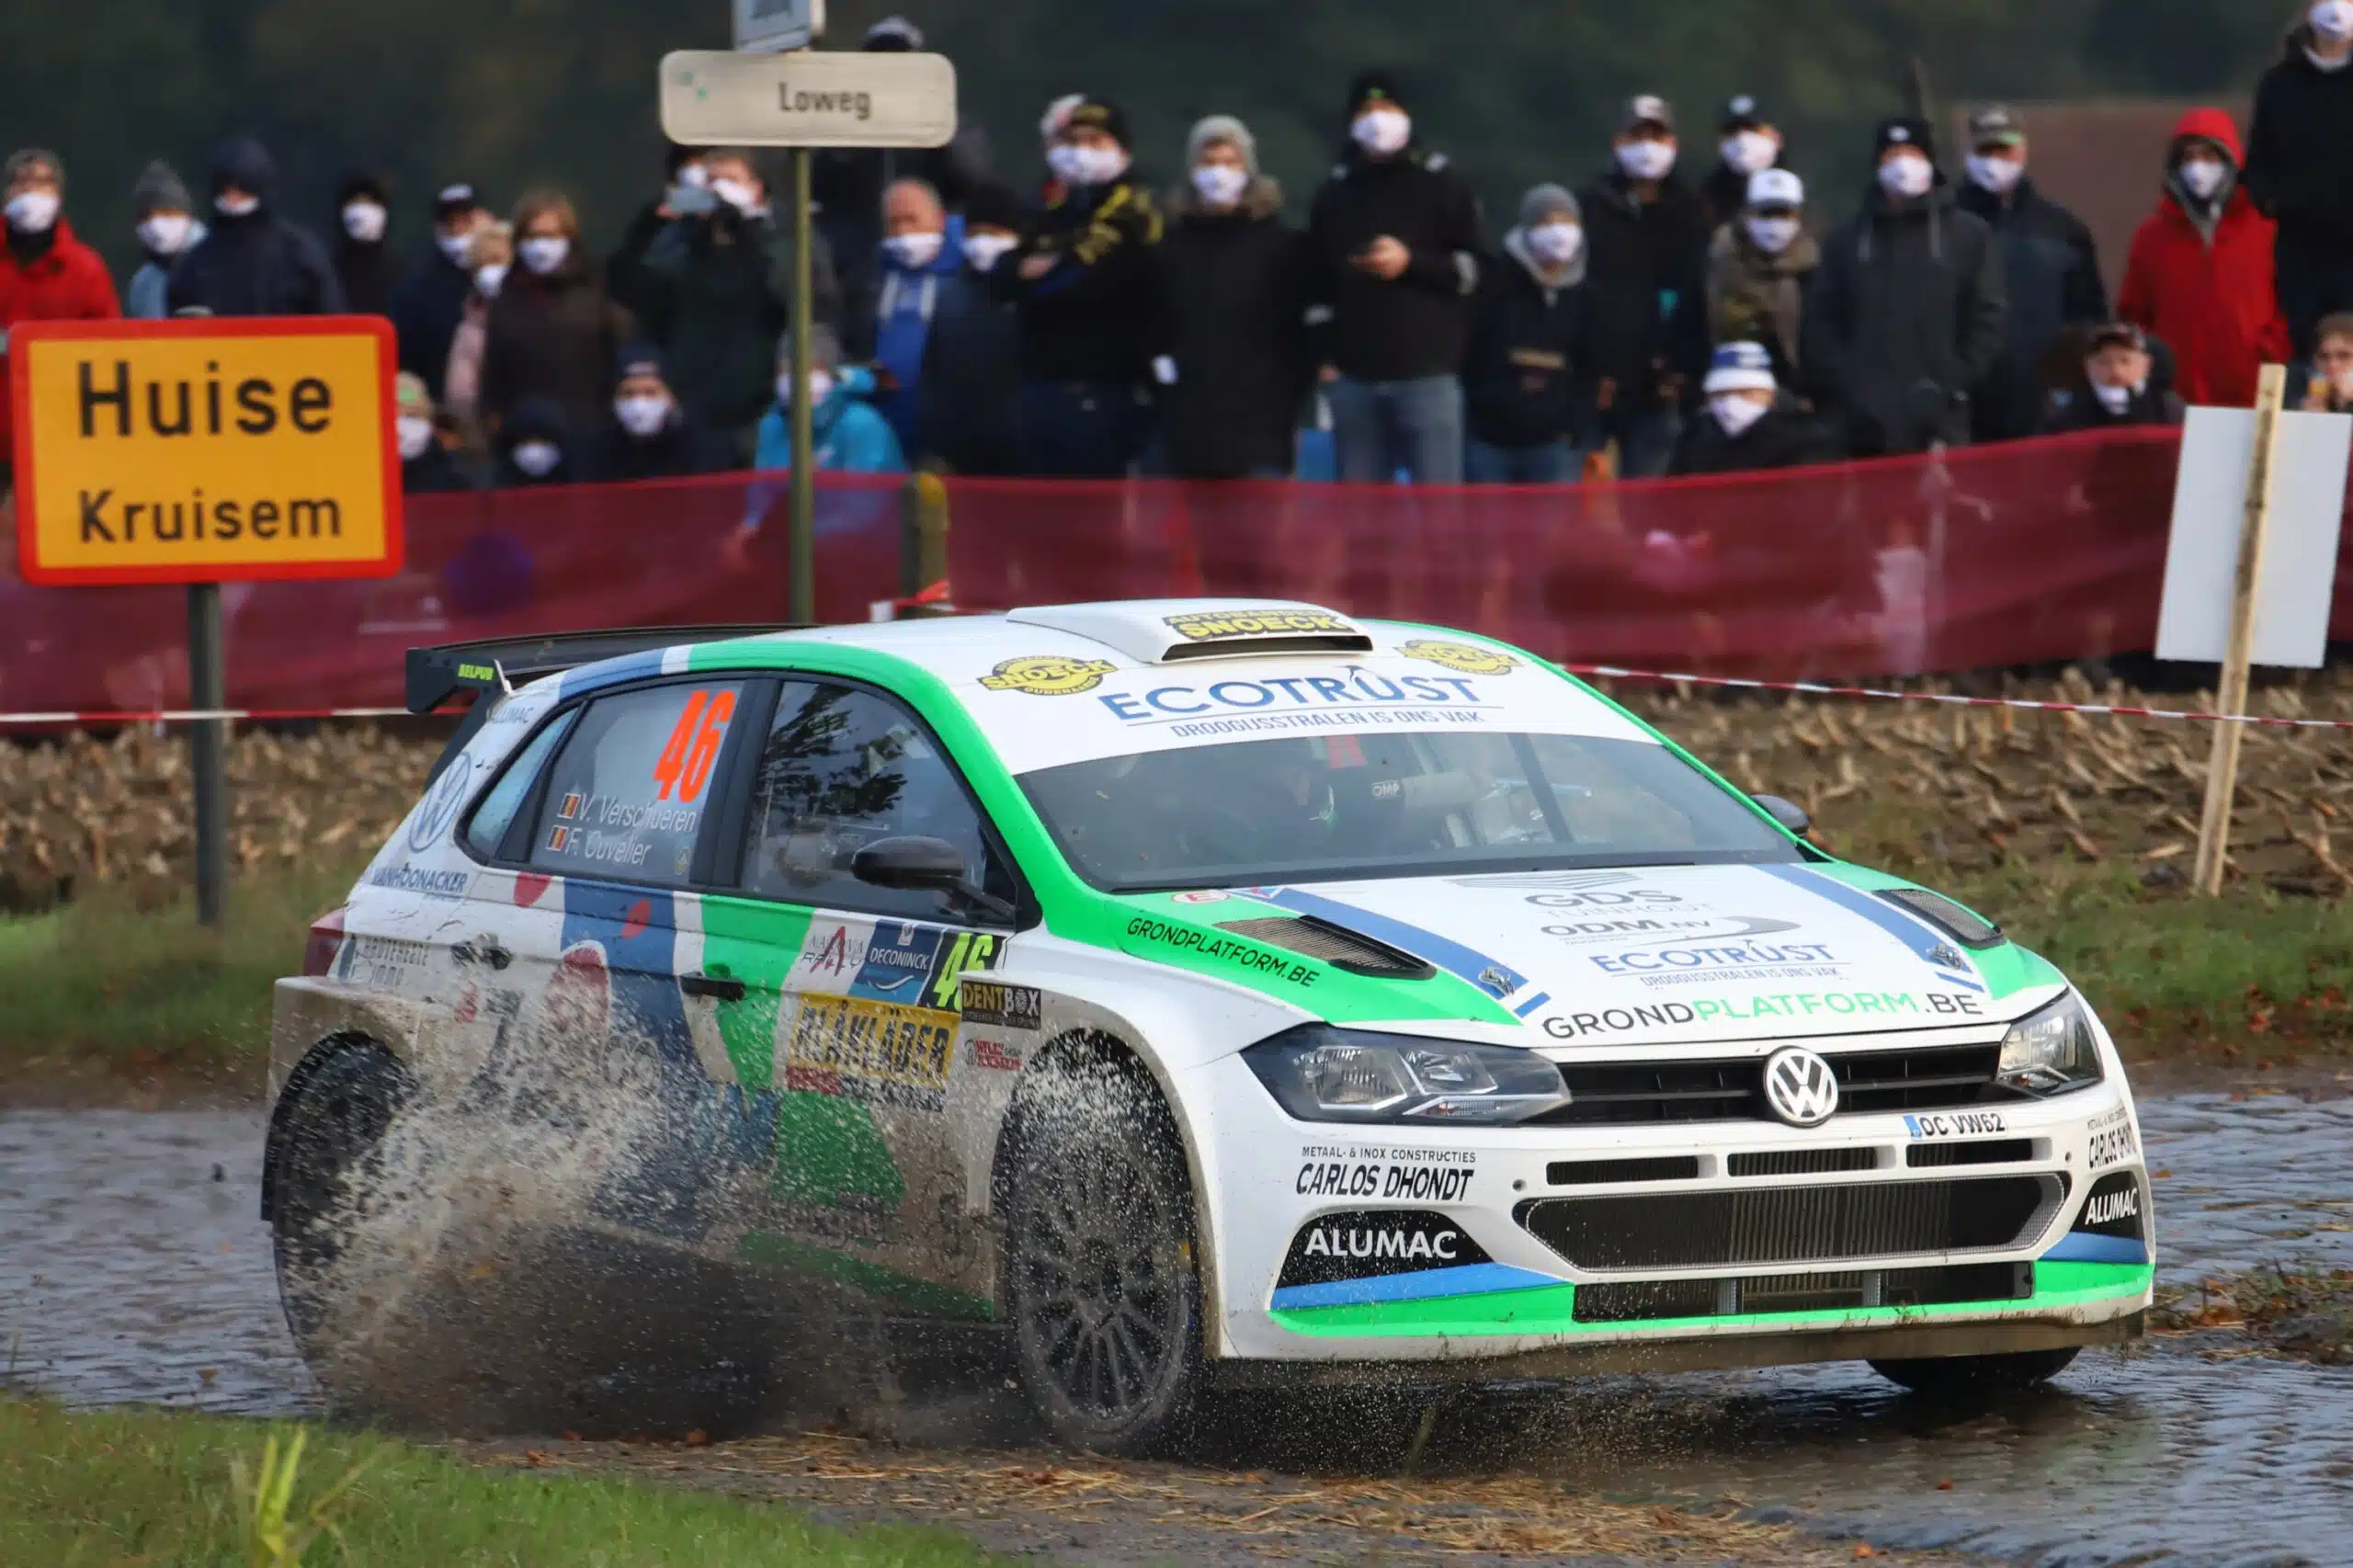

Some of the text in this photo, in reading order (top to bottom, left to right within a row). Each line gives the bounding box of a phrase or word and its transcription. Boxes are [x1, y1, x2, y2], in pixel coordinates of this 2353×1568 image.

[777, 82, 871, 121] Loweg
[76, 359, 333, 438] Huise
[78, 486, 343, 544] Kruisem
[1178, 616, 1351, 639] SNOECK
[981, 659, 1110, 689] SNOECK
[1097, 676, 1481, 721] ECOTRUST
[1369, 711, 1394, 724] IS
[1393, 710, 1438, 723] ONS
[1439, 710, 1485, 723] VAK
[653, 689, 735, 804] 46
[578, 792, 697, 833] V. Verschueren
[563, 827, 653, 866] F. Cuvelier
[1524, 890, 1683, 908] GDS
[1540, 919, 1665, 936] ODM
[870, 947, 931, 971] DECONINCK
[1126, 916, 1321, 989] GRONDPLATFORM.BE
[1587, 944, 1836, 972] ECOTRUST
[962, 982, 1040, 1017] DENTBOX
[1541, 992, 1984, 1040] GRONDPLATFORM.BE
[1302, 1146, 1476, 1163] METAAL- & INOX CONSTRUCTIES
[2088, 1129, 2118, 1169] CARLOS
[1296, 1163, 1474, 1202] CARLOS DHONDT
[2085, 1187, 2138, 1226] ALUMAC
[1303, 1227, 1457, 1260] ALUMAC
